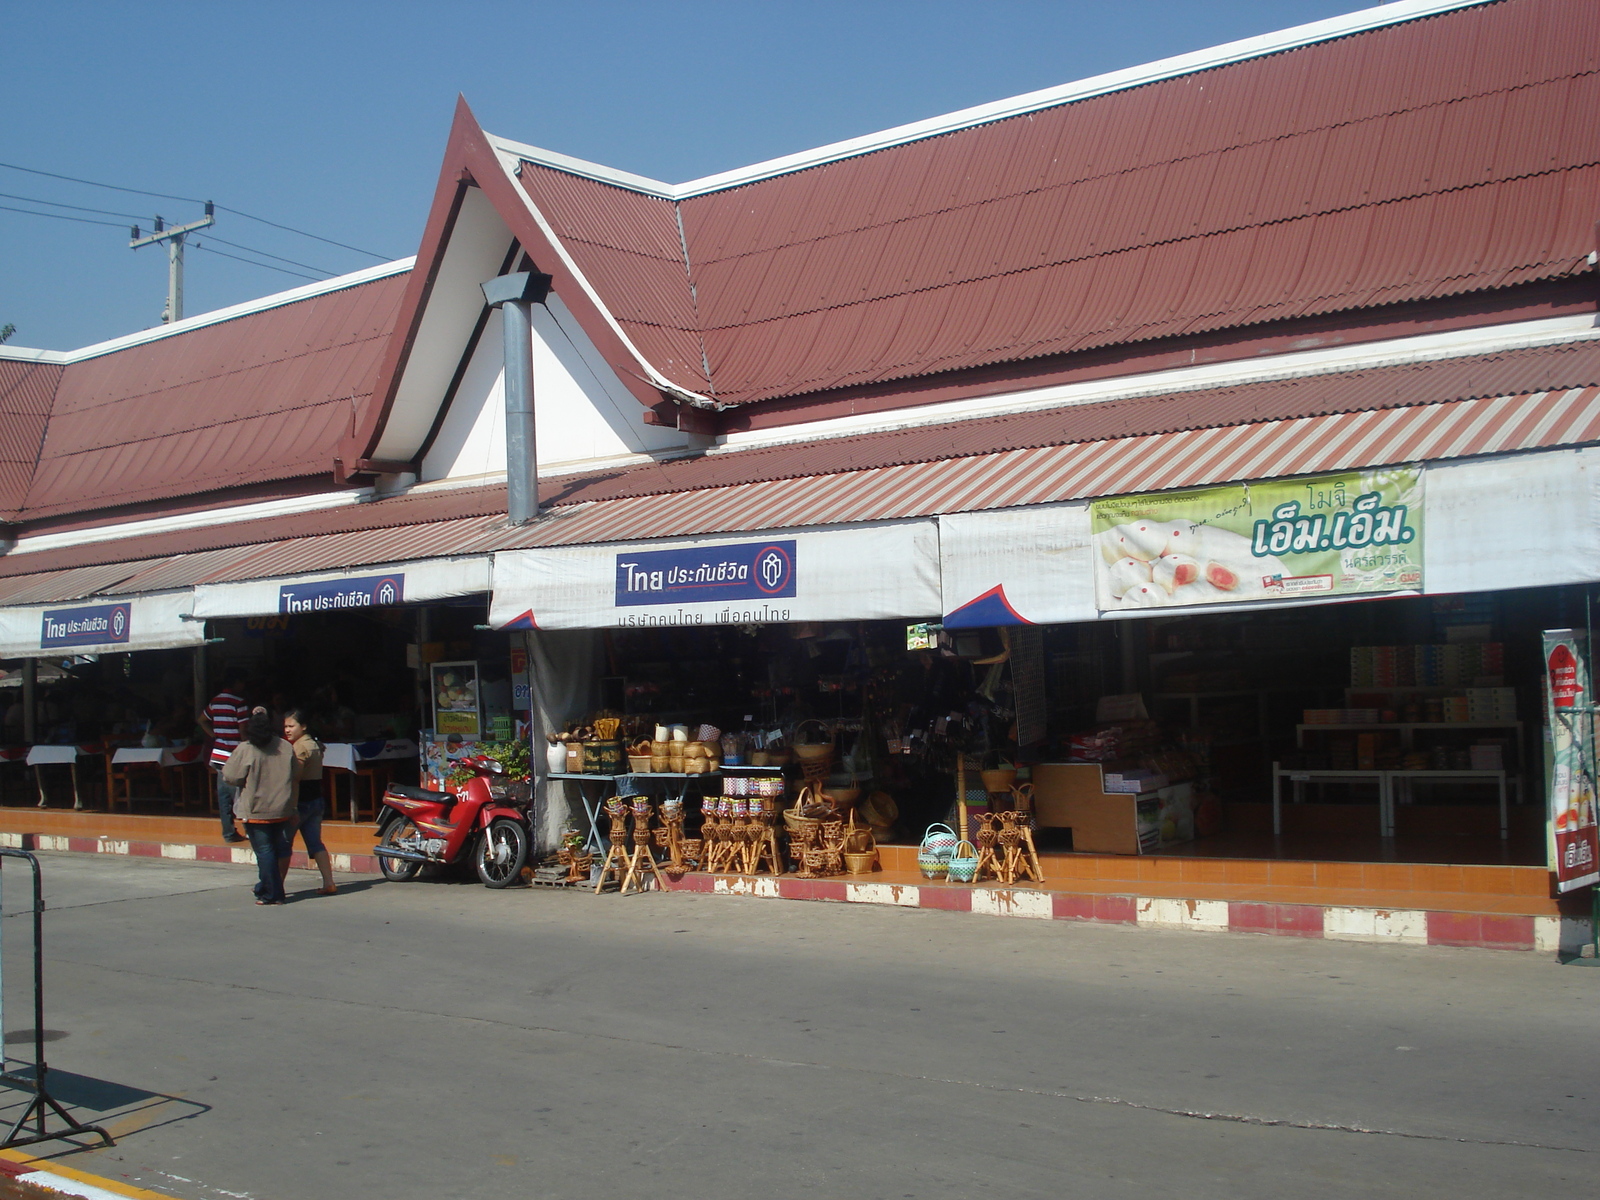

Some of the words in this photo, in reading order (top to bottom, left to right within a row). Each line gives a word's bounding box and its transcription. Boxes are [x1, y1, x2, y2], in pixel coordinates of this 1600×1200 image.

[1306, 481, 1346, 510] โมจิ
[1344, 550, 1407, 569] นครสวรรค์
[620, 563, 663, 592] ไทย
[667, 561, 748, 584] ประกันชีวิต
[282, 593, 312, 614] ไทย
[314, 590, 371, 611] ประกันชีวิต
[618, 608, 703, 627] บริษัทคนไทย
[715, 604, 791, 624] เพื่อคนไทย
[44, 617, 67, 639] ไทย
[67, 616, 108, 633] ประกันชีวิต
